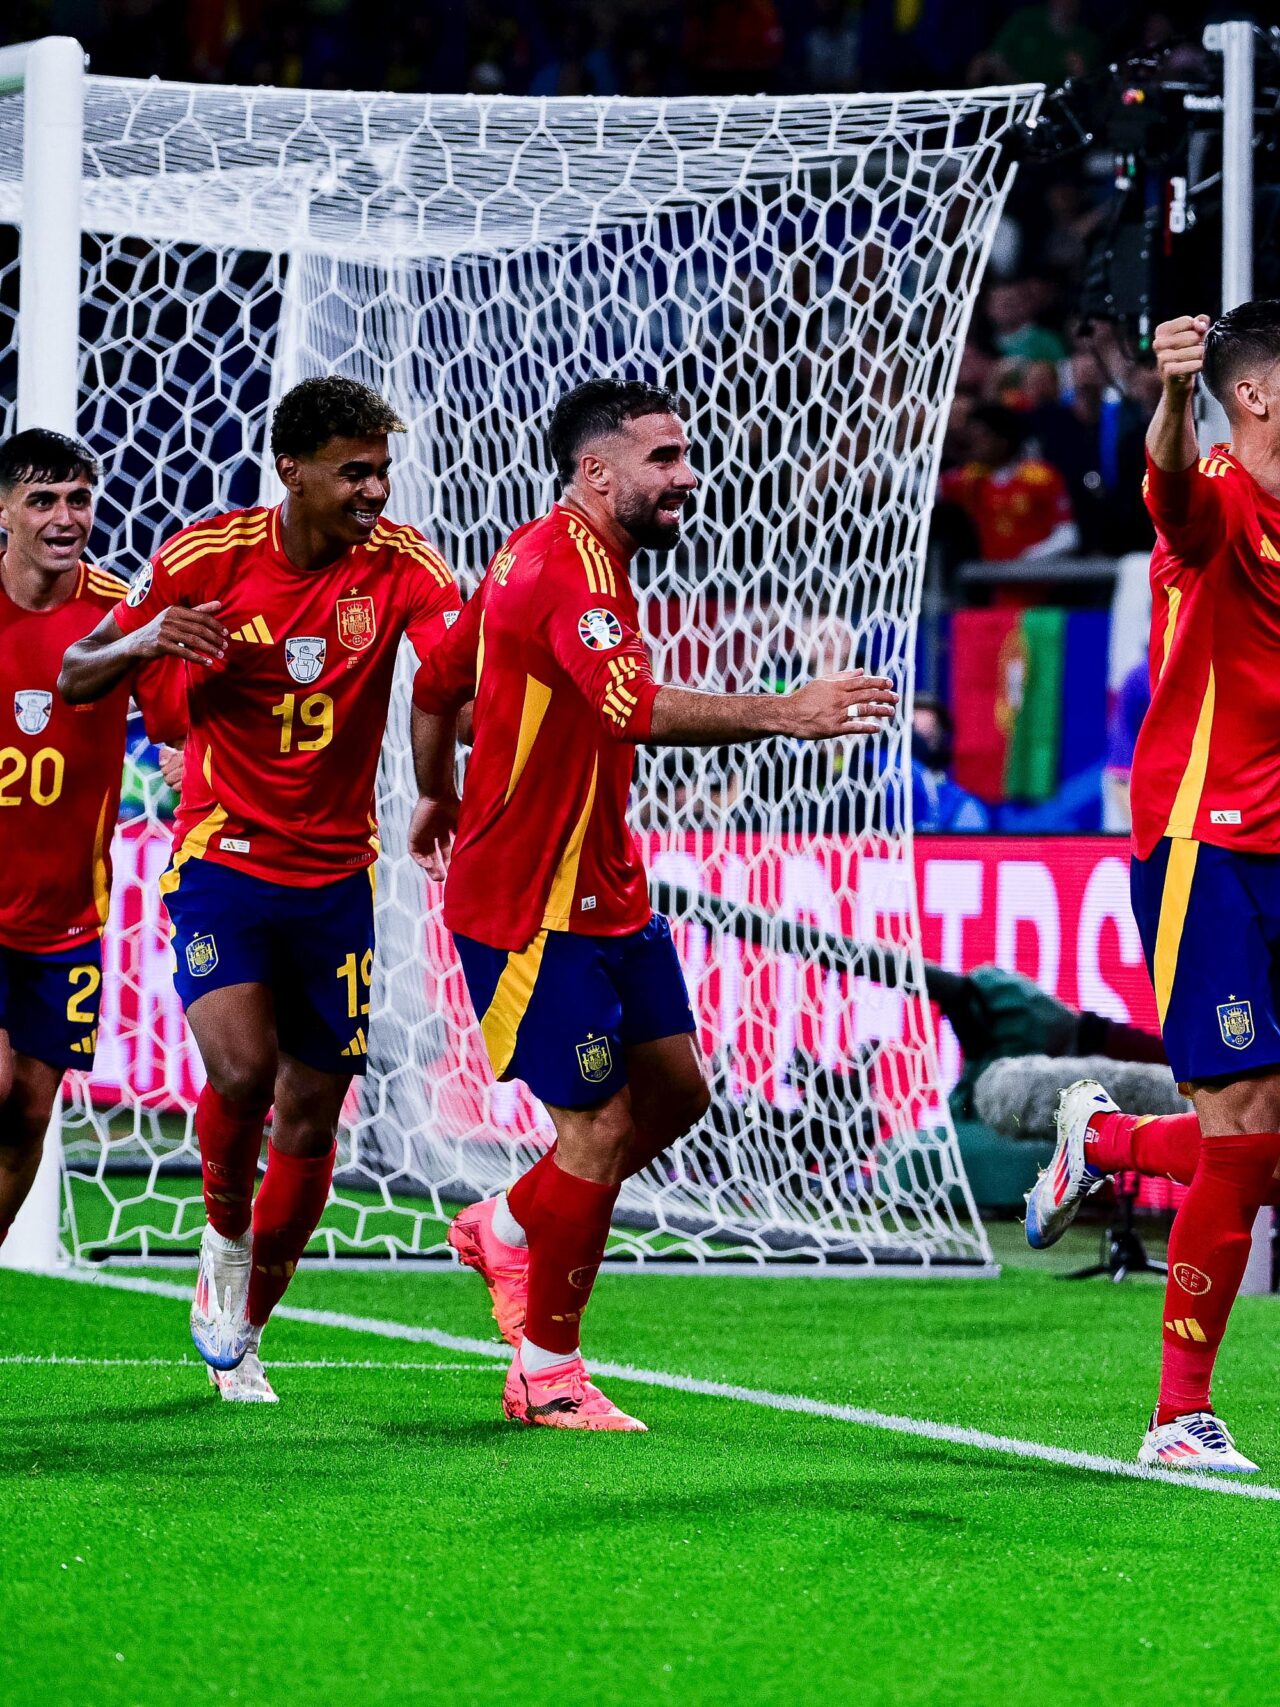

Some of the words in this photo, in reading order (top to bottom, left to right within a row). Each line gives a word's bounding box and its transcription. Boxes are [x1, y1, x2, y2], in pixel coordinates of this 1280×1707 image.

[272, 692, 333, 752] 19
[0, 747, 65, 806] 20
[67, 964, 101, 1023] 2
